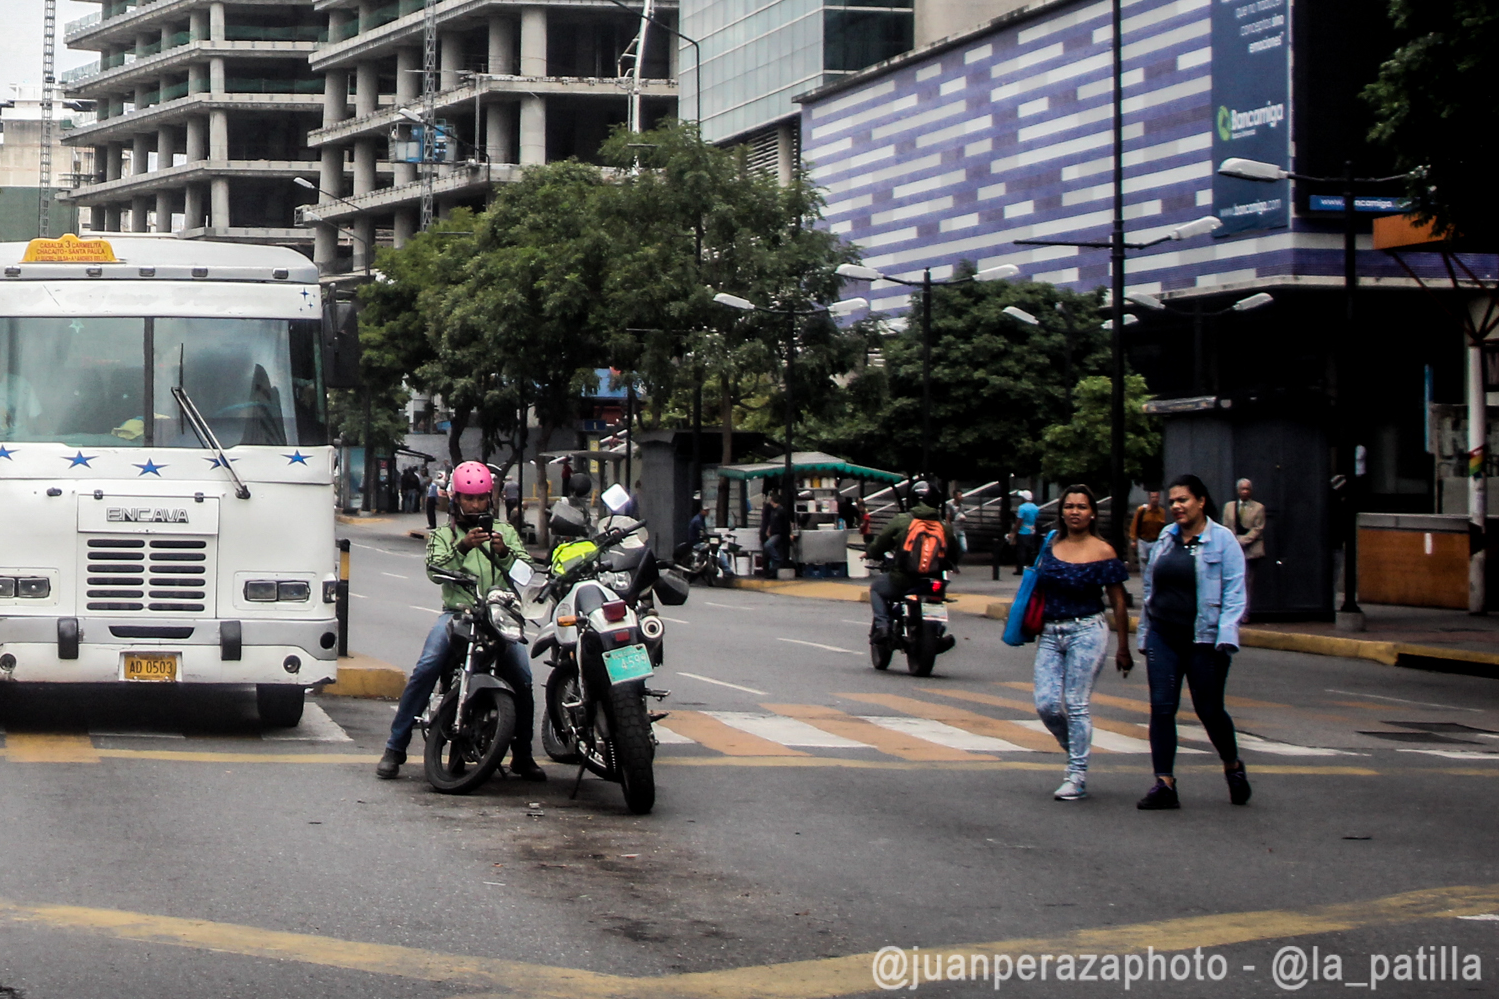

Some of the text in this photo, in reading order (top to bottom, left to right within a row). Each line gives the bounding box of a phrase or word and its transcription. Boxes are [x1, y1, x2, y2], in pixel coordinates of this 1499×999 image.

[65, 240, 71, 249] 3
[106, 507, 190, 524] ENCAVA
[129, 660, 173, 675] AD 0503
